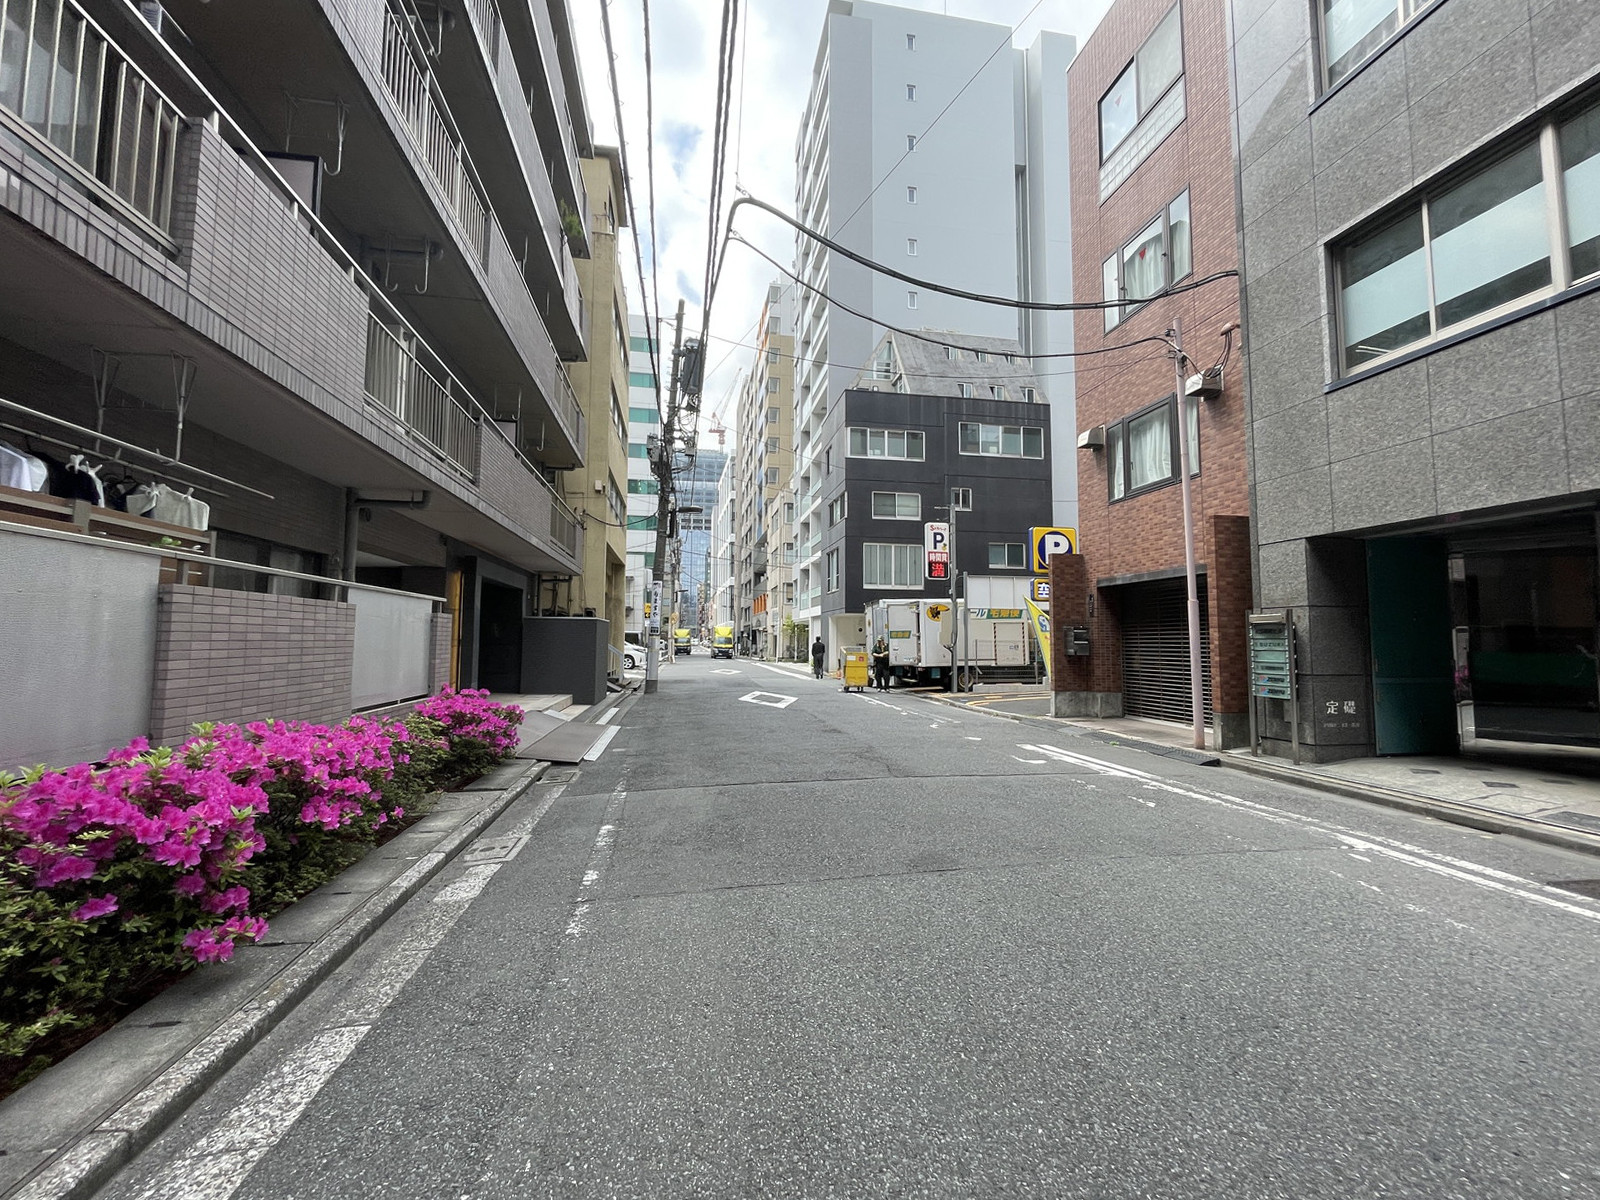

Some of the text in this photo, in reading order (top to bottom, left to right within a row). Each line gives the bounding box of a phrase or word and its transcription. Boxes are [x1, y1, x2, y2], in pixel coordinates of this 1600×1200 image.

[933, 532, 945, 550] P
[1044, 534, 1069, 564] P
[932, 563, 945, 577] 満
